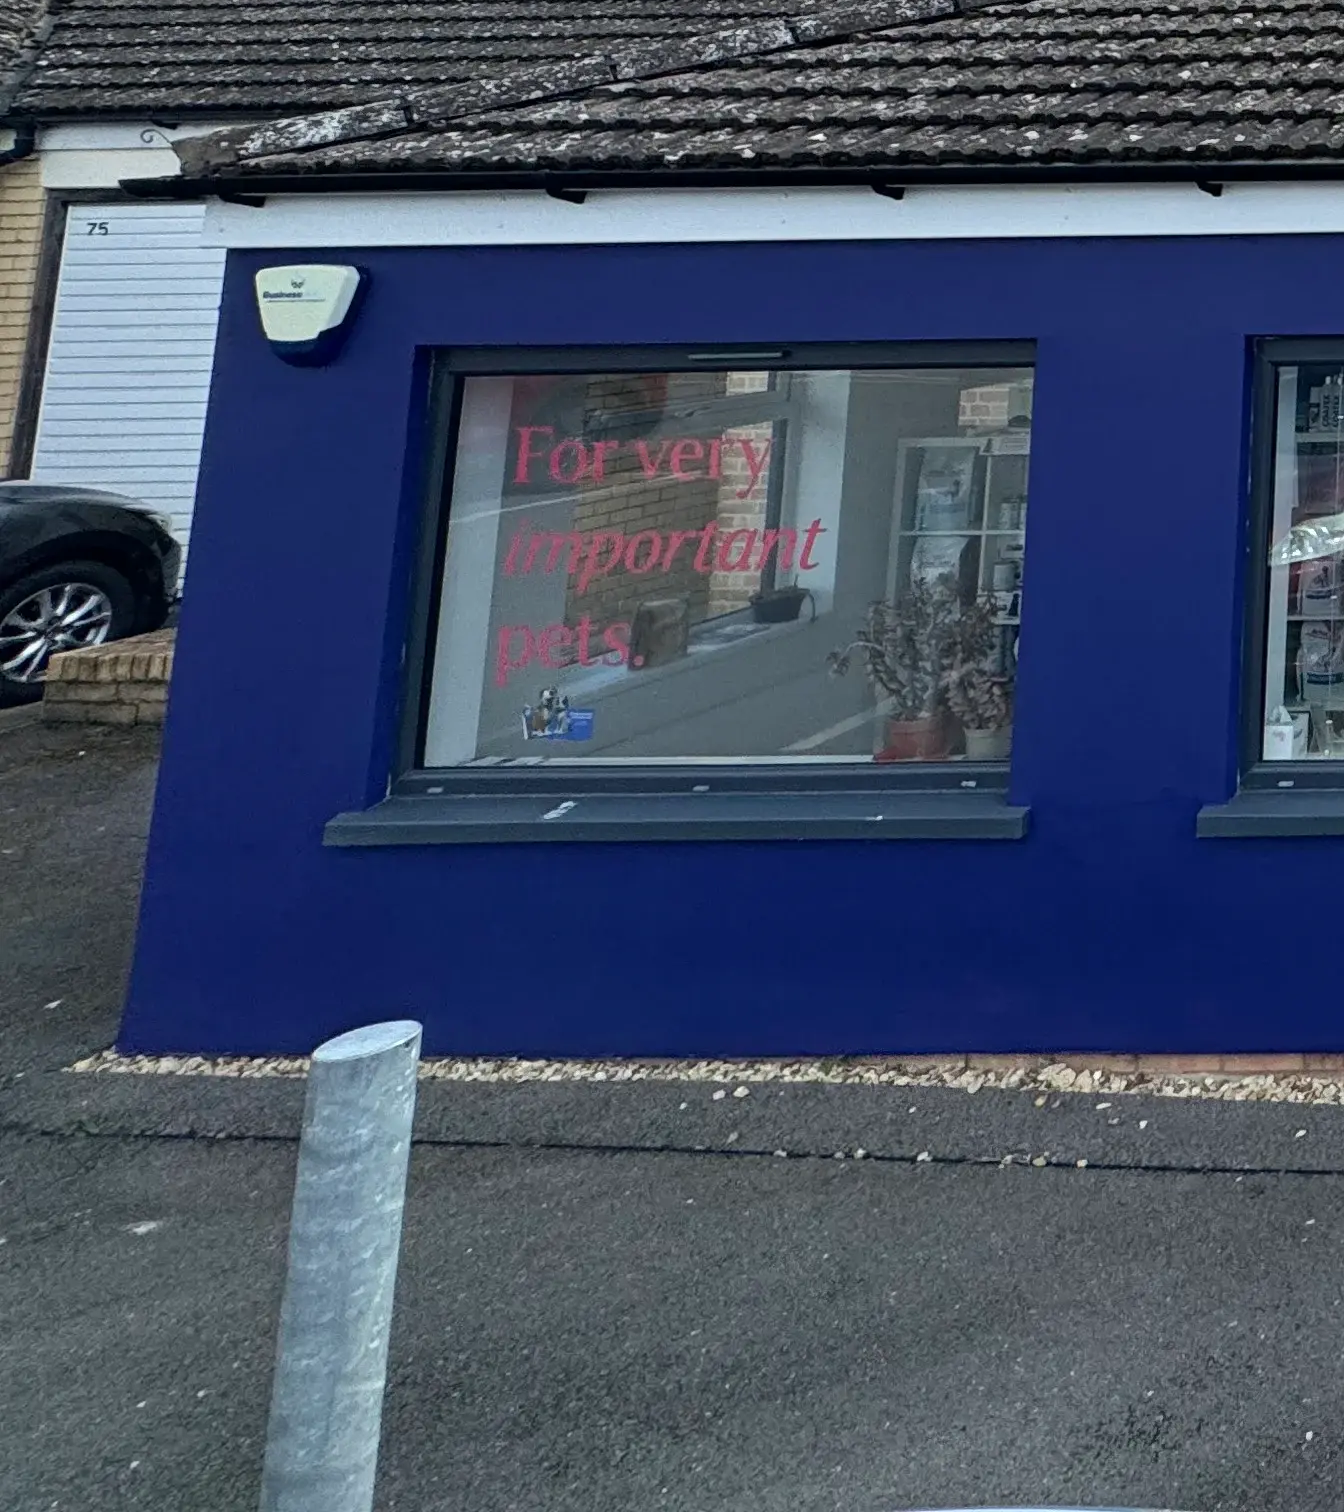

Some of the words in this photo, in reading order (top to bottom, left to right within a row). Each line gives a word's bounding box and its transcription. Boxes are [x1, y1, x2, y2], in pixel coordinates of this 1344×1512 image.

[87, 222, 109, 235] 75
[513, 426, 618, 483] For
[633, 437, 773, 499] very
[504, 518, 826, 596] important
[495, 615, 644, 688] pets.
